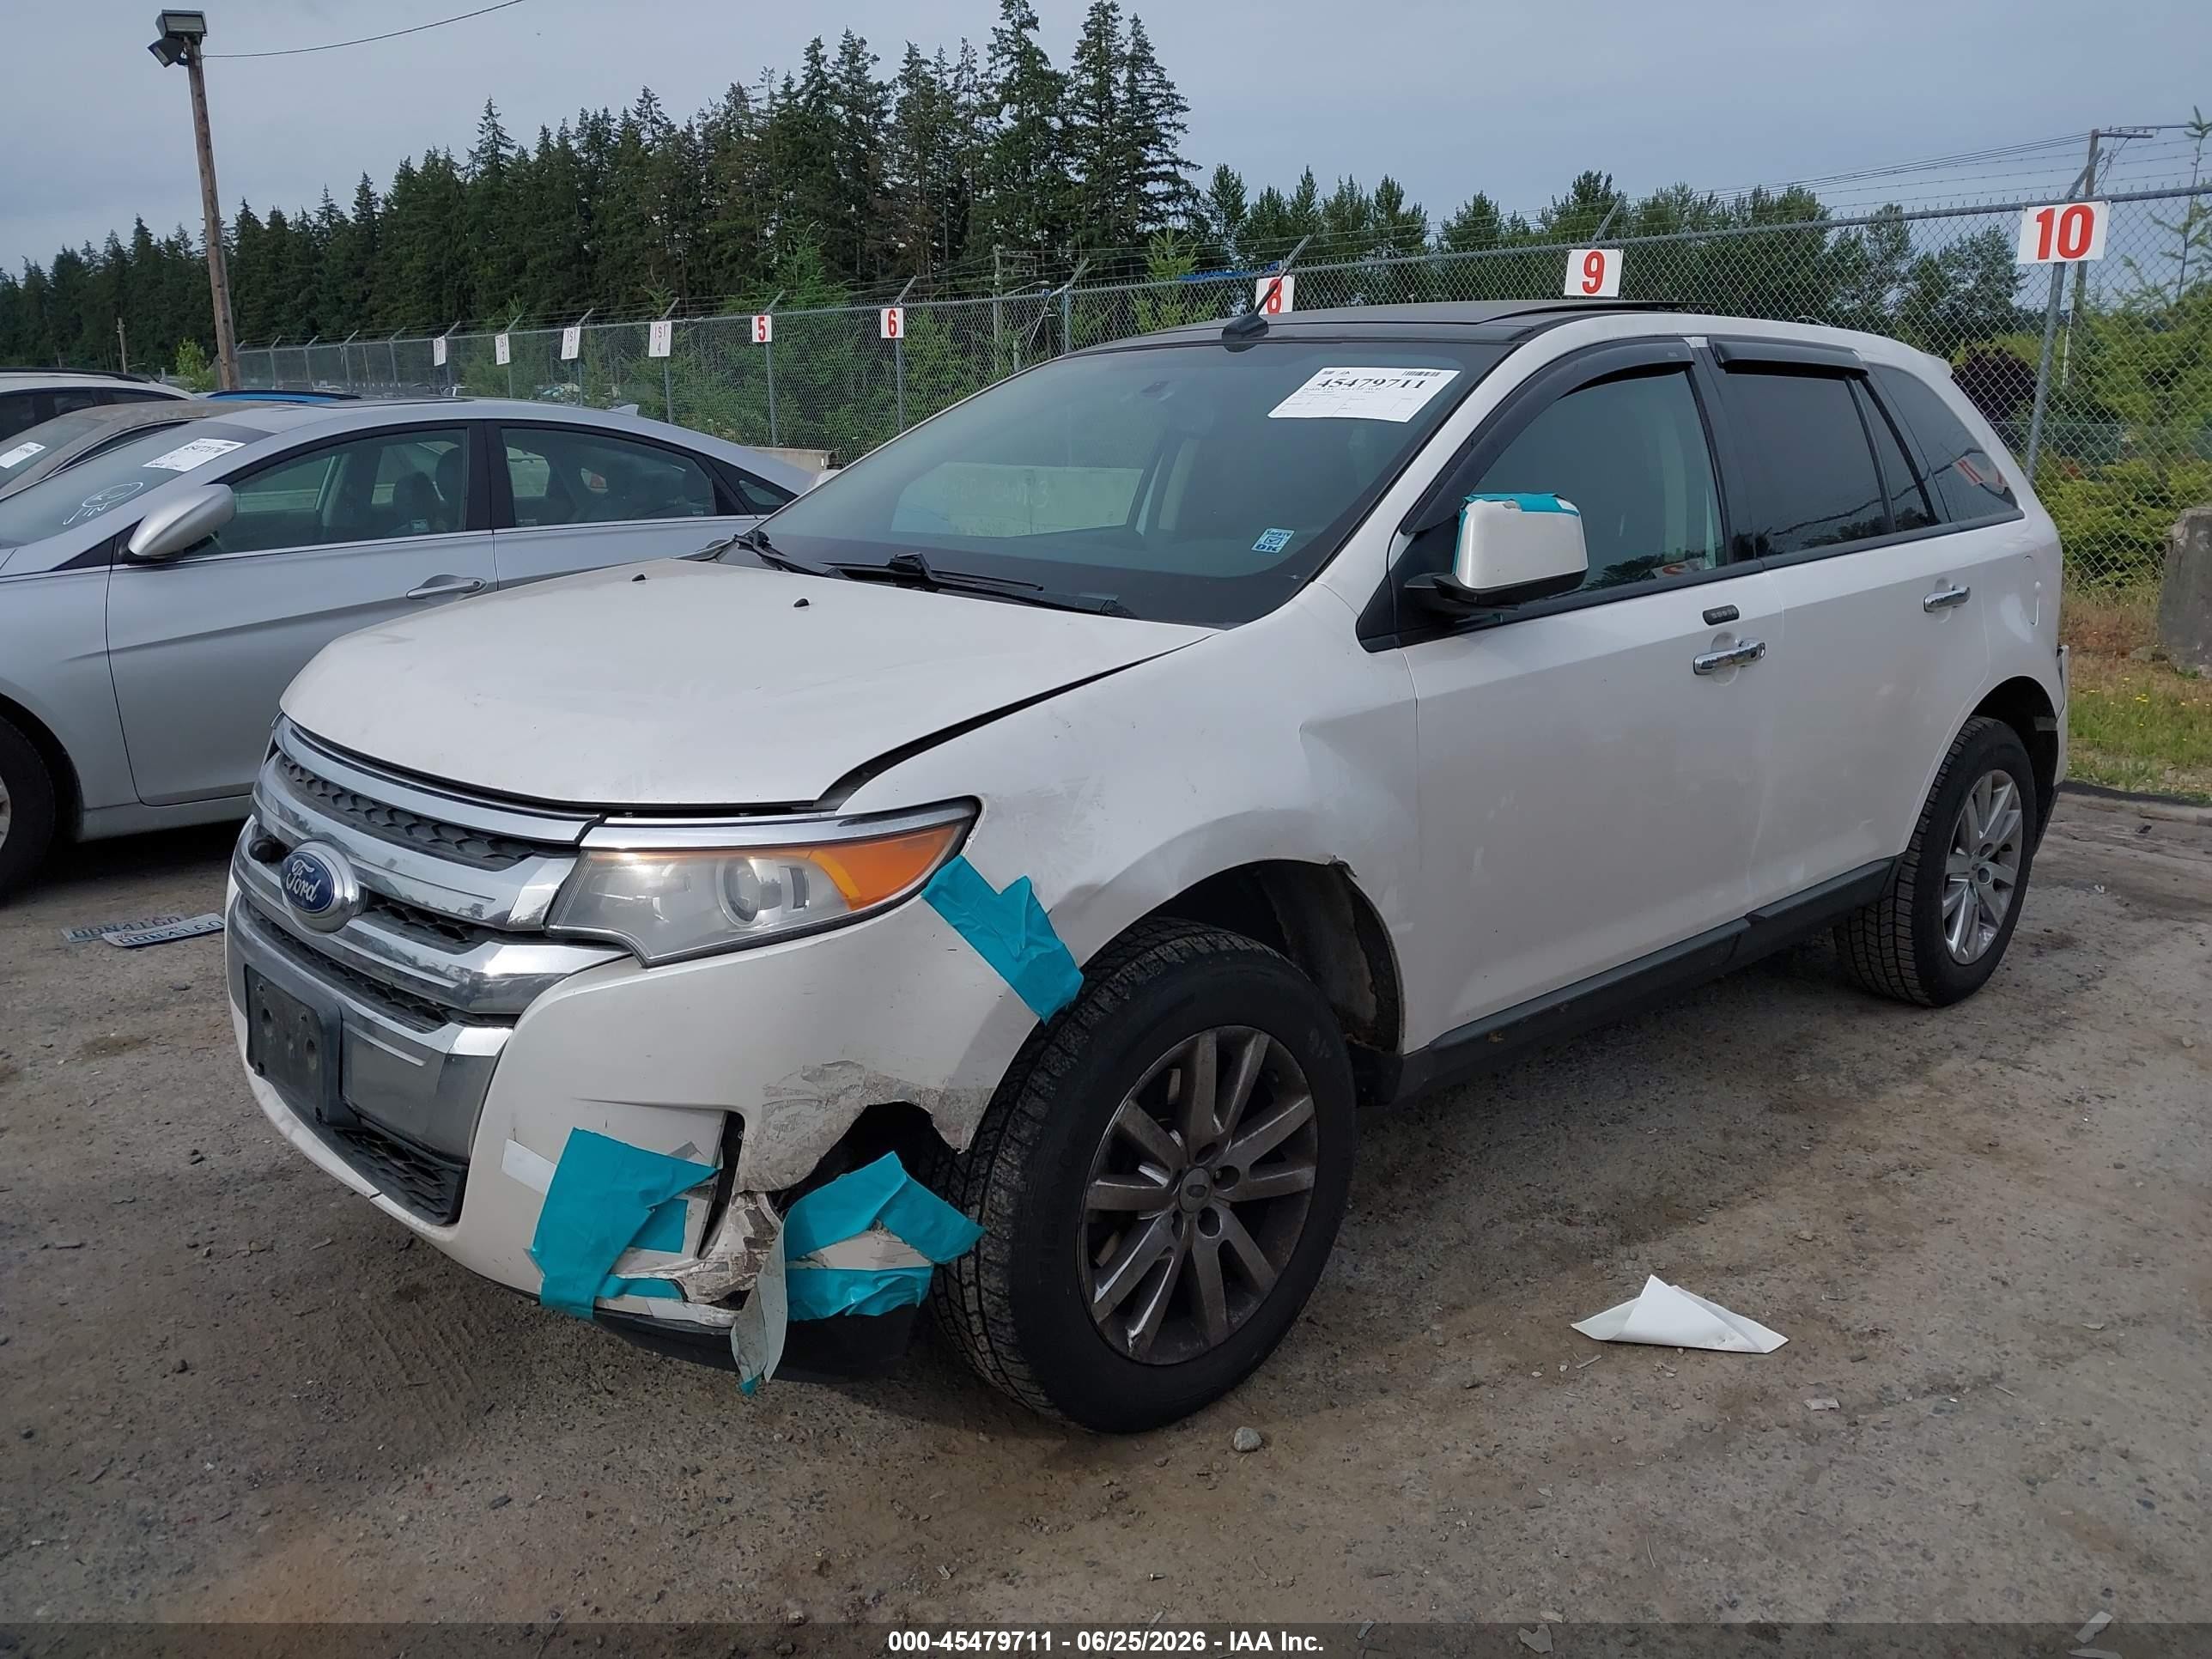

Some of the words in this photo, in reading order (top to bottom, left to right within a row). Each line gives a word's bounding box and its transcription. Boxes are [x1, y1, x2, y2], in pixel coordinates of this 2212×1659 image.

[2035, 204, 2095, 259] 10
[1582, 250, 1606, 295] 9
[1267, 278, 1283, 314] 8
[757, 316, 766, 341] 5
[887, 309, 897, 337] 6
[1317, 377, 1427, 389] 45479711
[286, 859, 322, 902] Ford
